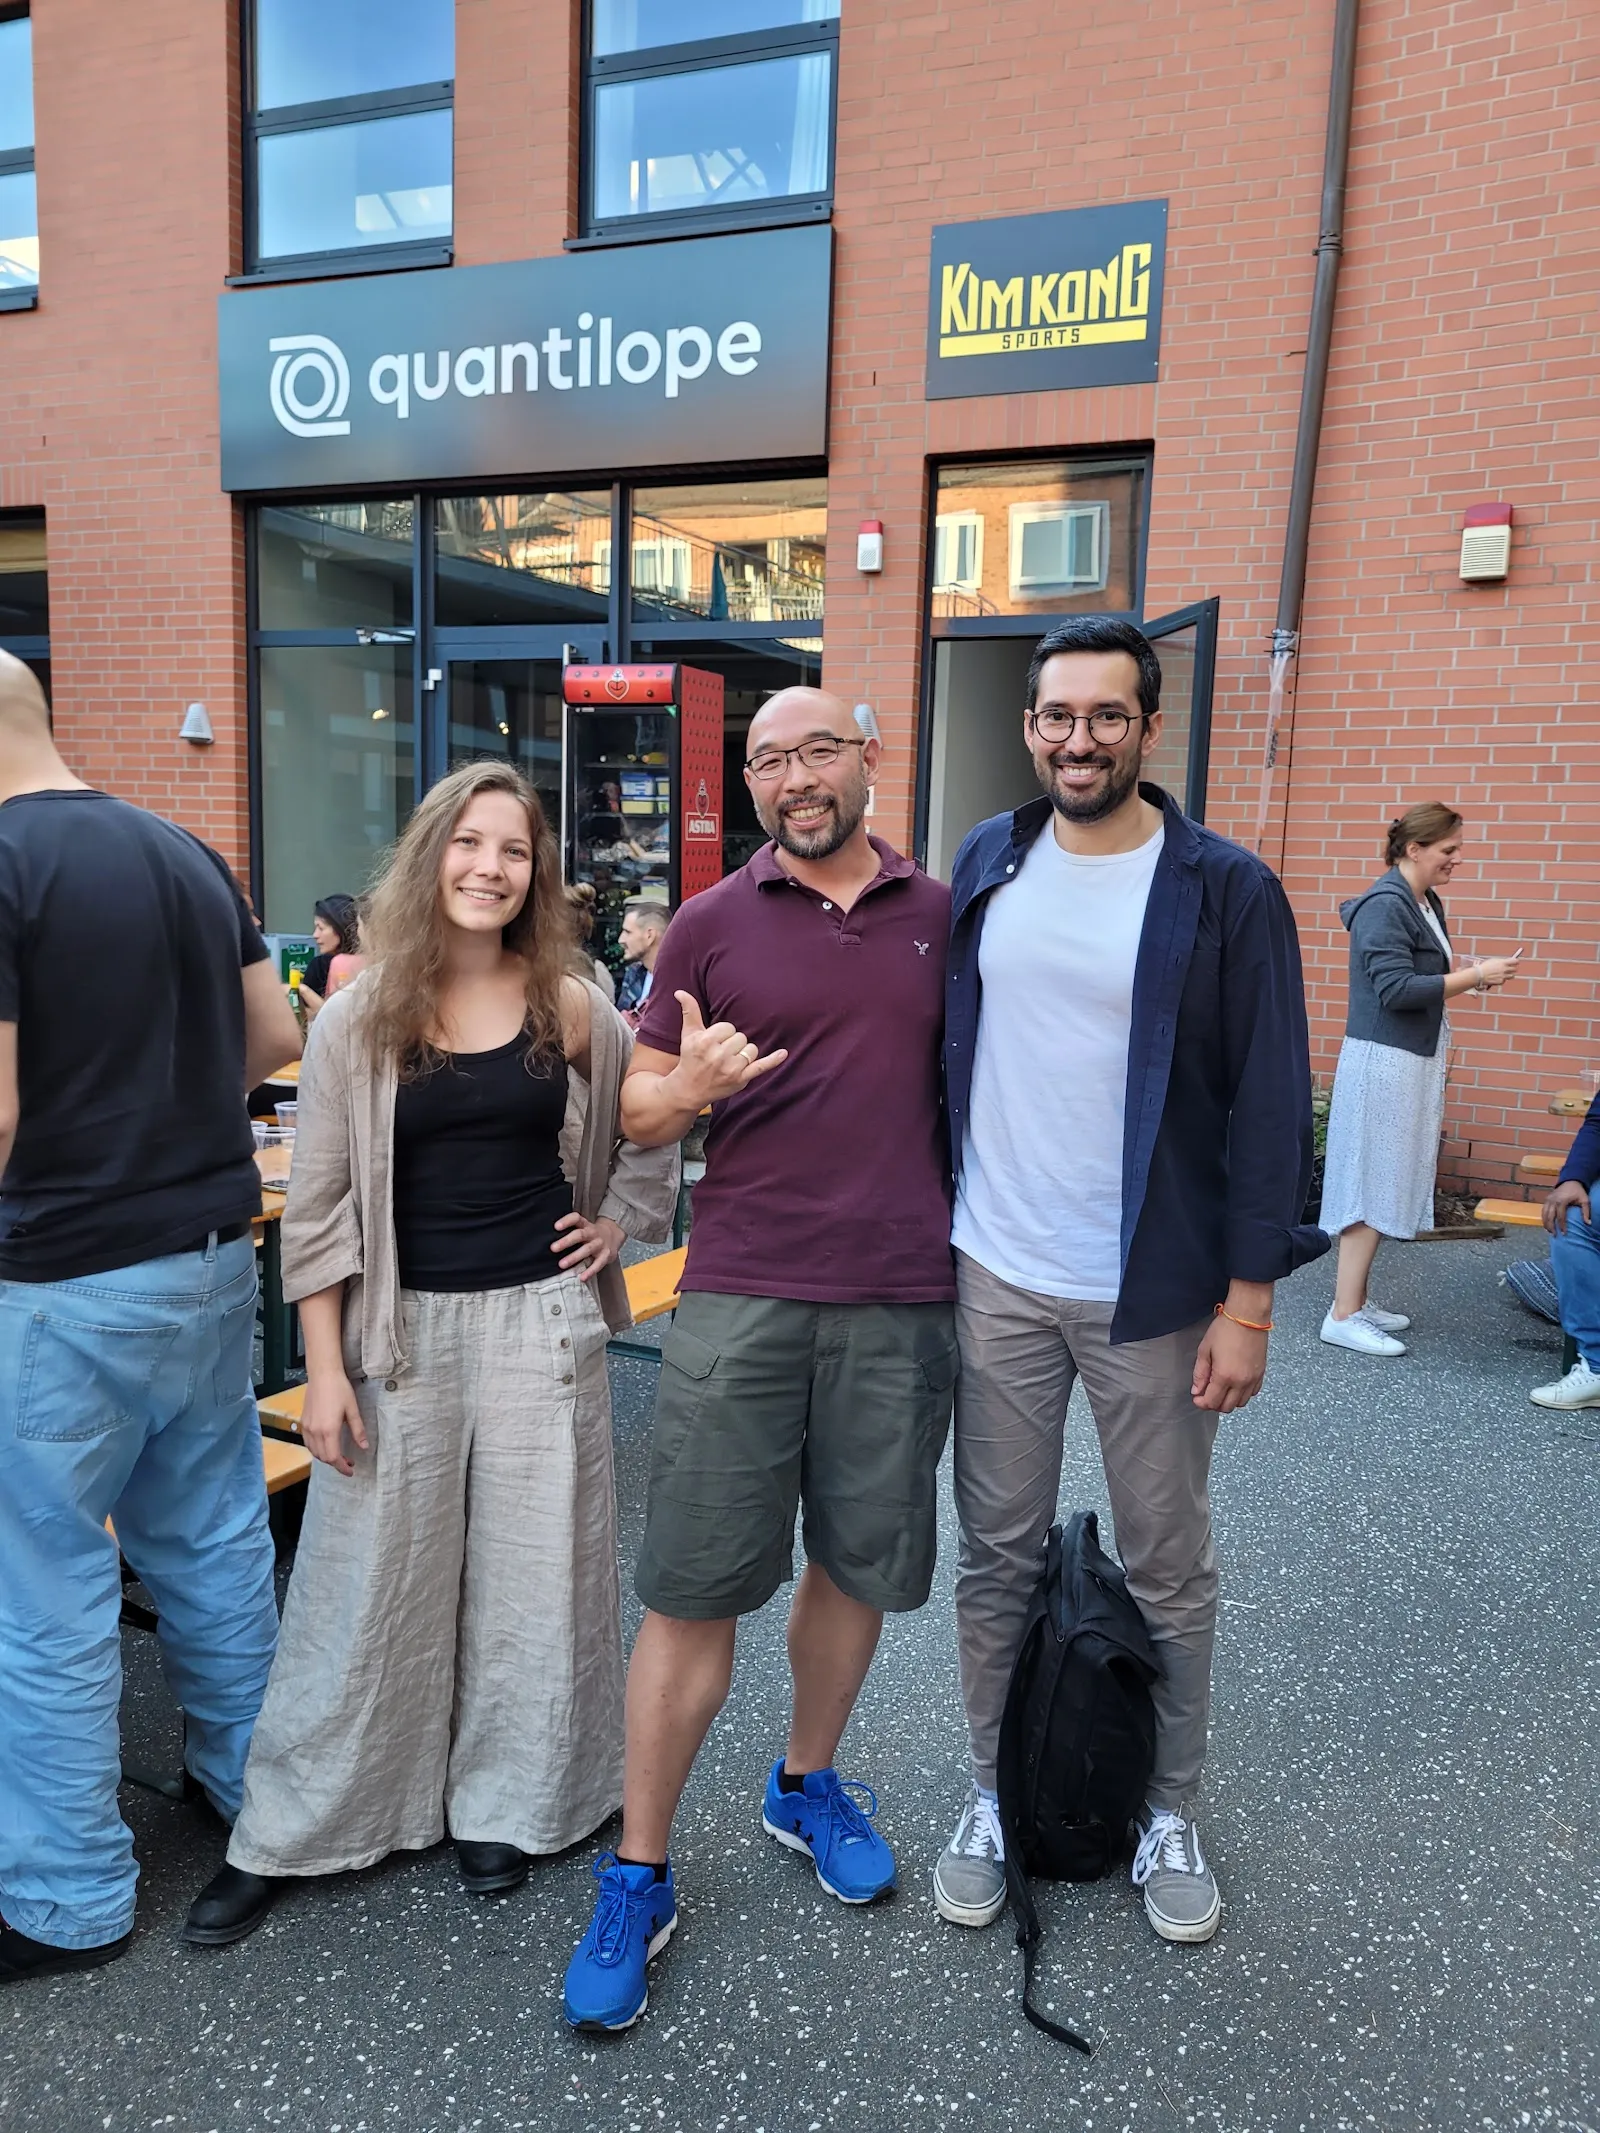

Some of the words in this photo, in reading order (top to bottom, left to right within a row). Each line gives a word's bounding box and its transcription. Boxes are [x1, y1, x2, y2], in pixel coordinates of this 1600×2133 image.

[940, 262, 1024, 334] KIM
[1029, 243, 1152, 326] KONG
[369, 312, 762, 418] quantilope
[1002, 328, 1080, 350] SPORTS
[689, 820, 715, 834] ASTRA
